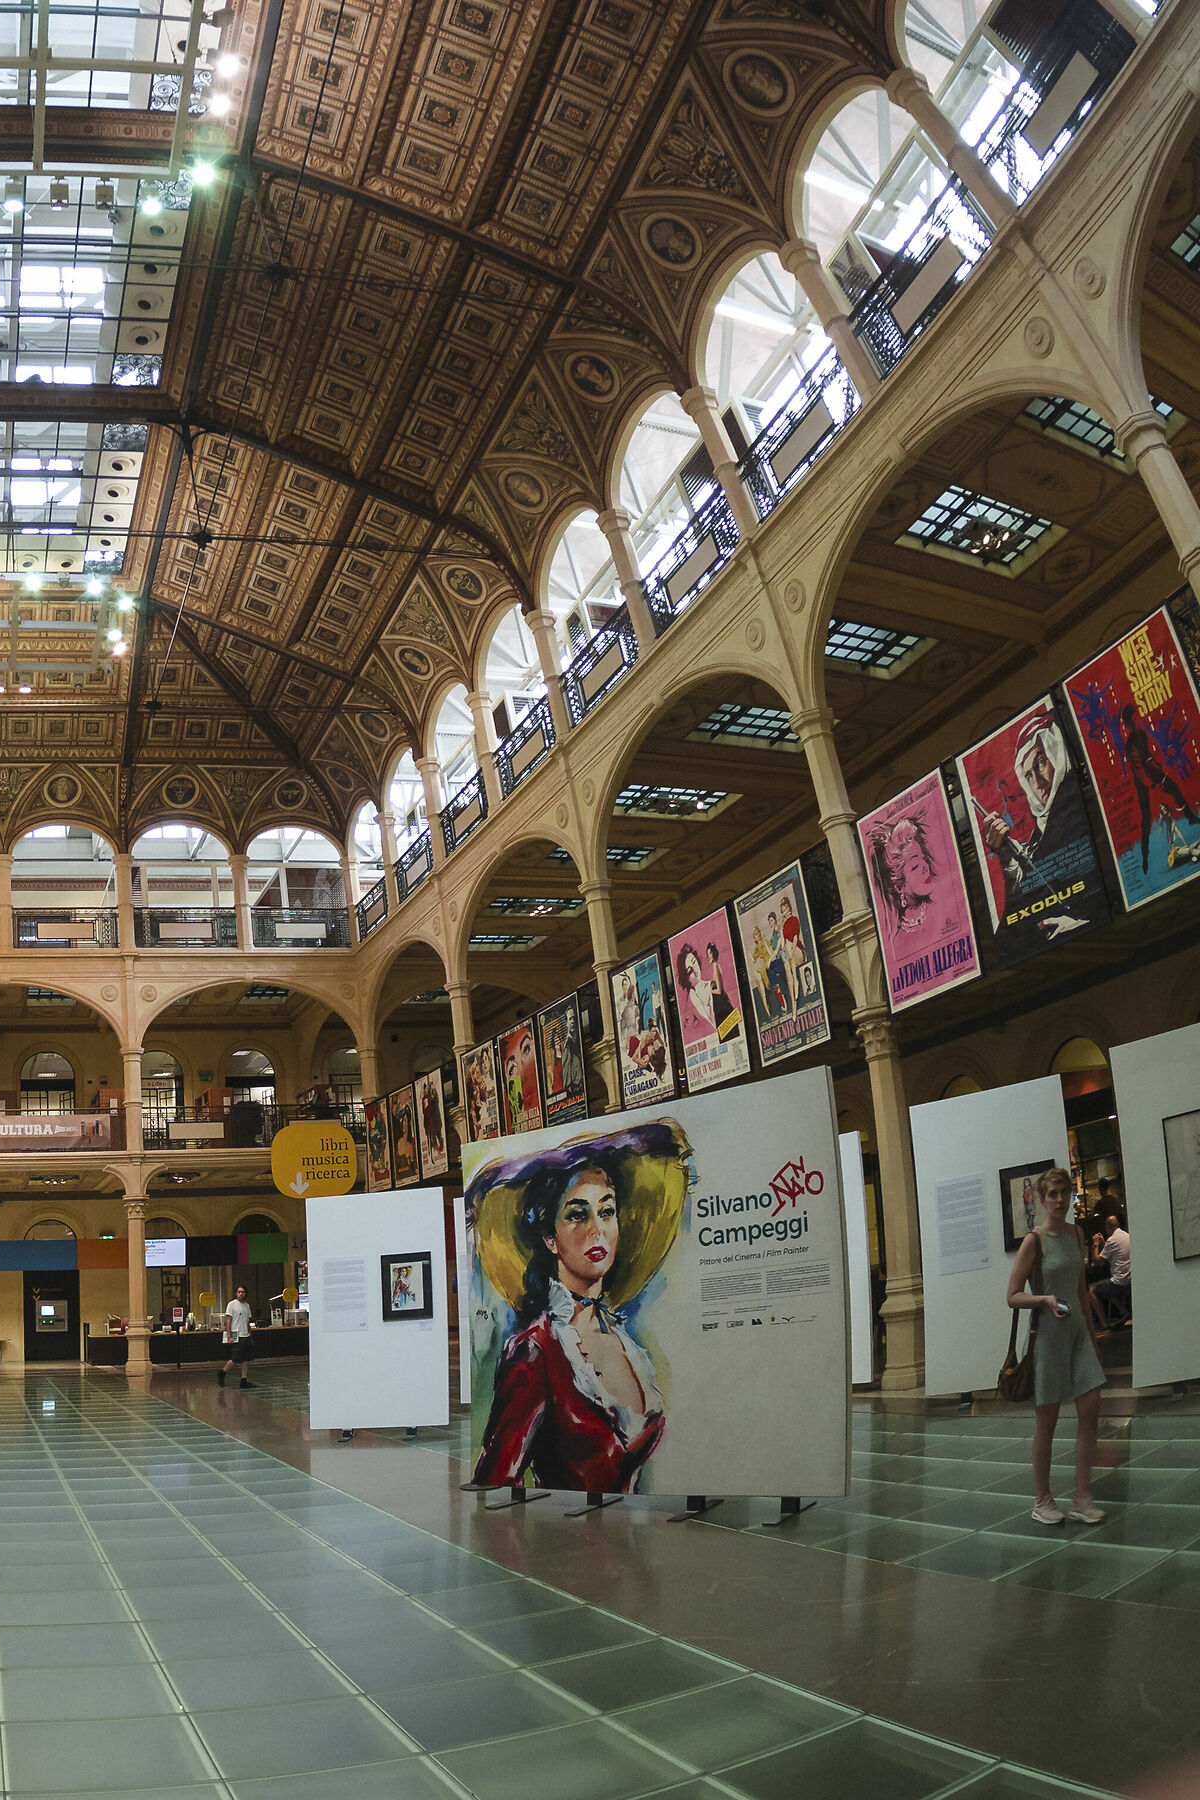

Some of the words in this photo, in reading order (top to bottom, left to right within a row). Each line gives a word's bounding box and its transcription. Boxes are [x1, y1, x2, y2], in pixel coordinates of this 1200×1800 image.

[1117, 624, 1153, 669] WEST
[1125, 651, 1161, 692] SIDE
[1134, 670, 1173, 717] STORY
[1006, 880, 1086, 925] EXODUS
[898, 954, 932, 990] VEDOVA
[931, 935, 973, 974] ALLEGRA
[760, 1019, 796, 1049] SOUVENIR
[302, 1152, 350, 1166] musica
[320, 1137, 349, 1151] libri
[305, 1167, 351, 1180] ricerca
[696, 1191, 773, 1219] Silvano
[698, 1209, 809, 1247] Campeggi
[699, 1257, 721, 1266] Pittore
[722, 1254, 734, 1263] del
[734, 1252, 761, 1262] Cinema
[766, 1248, 782, 1257] Film
[783, 1245, 810, 1255] Painter
